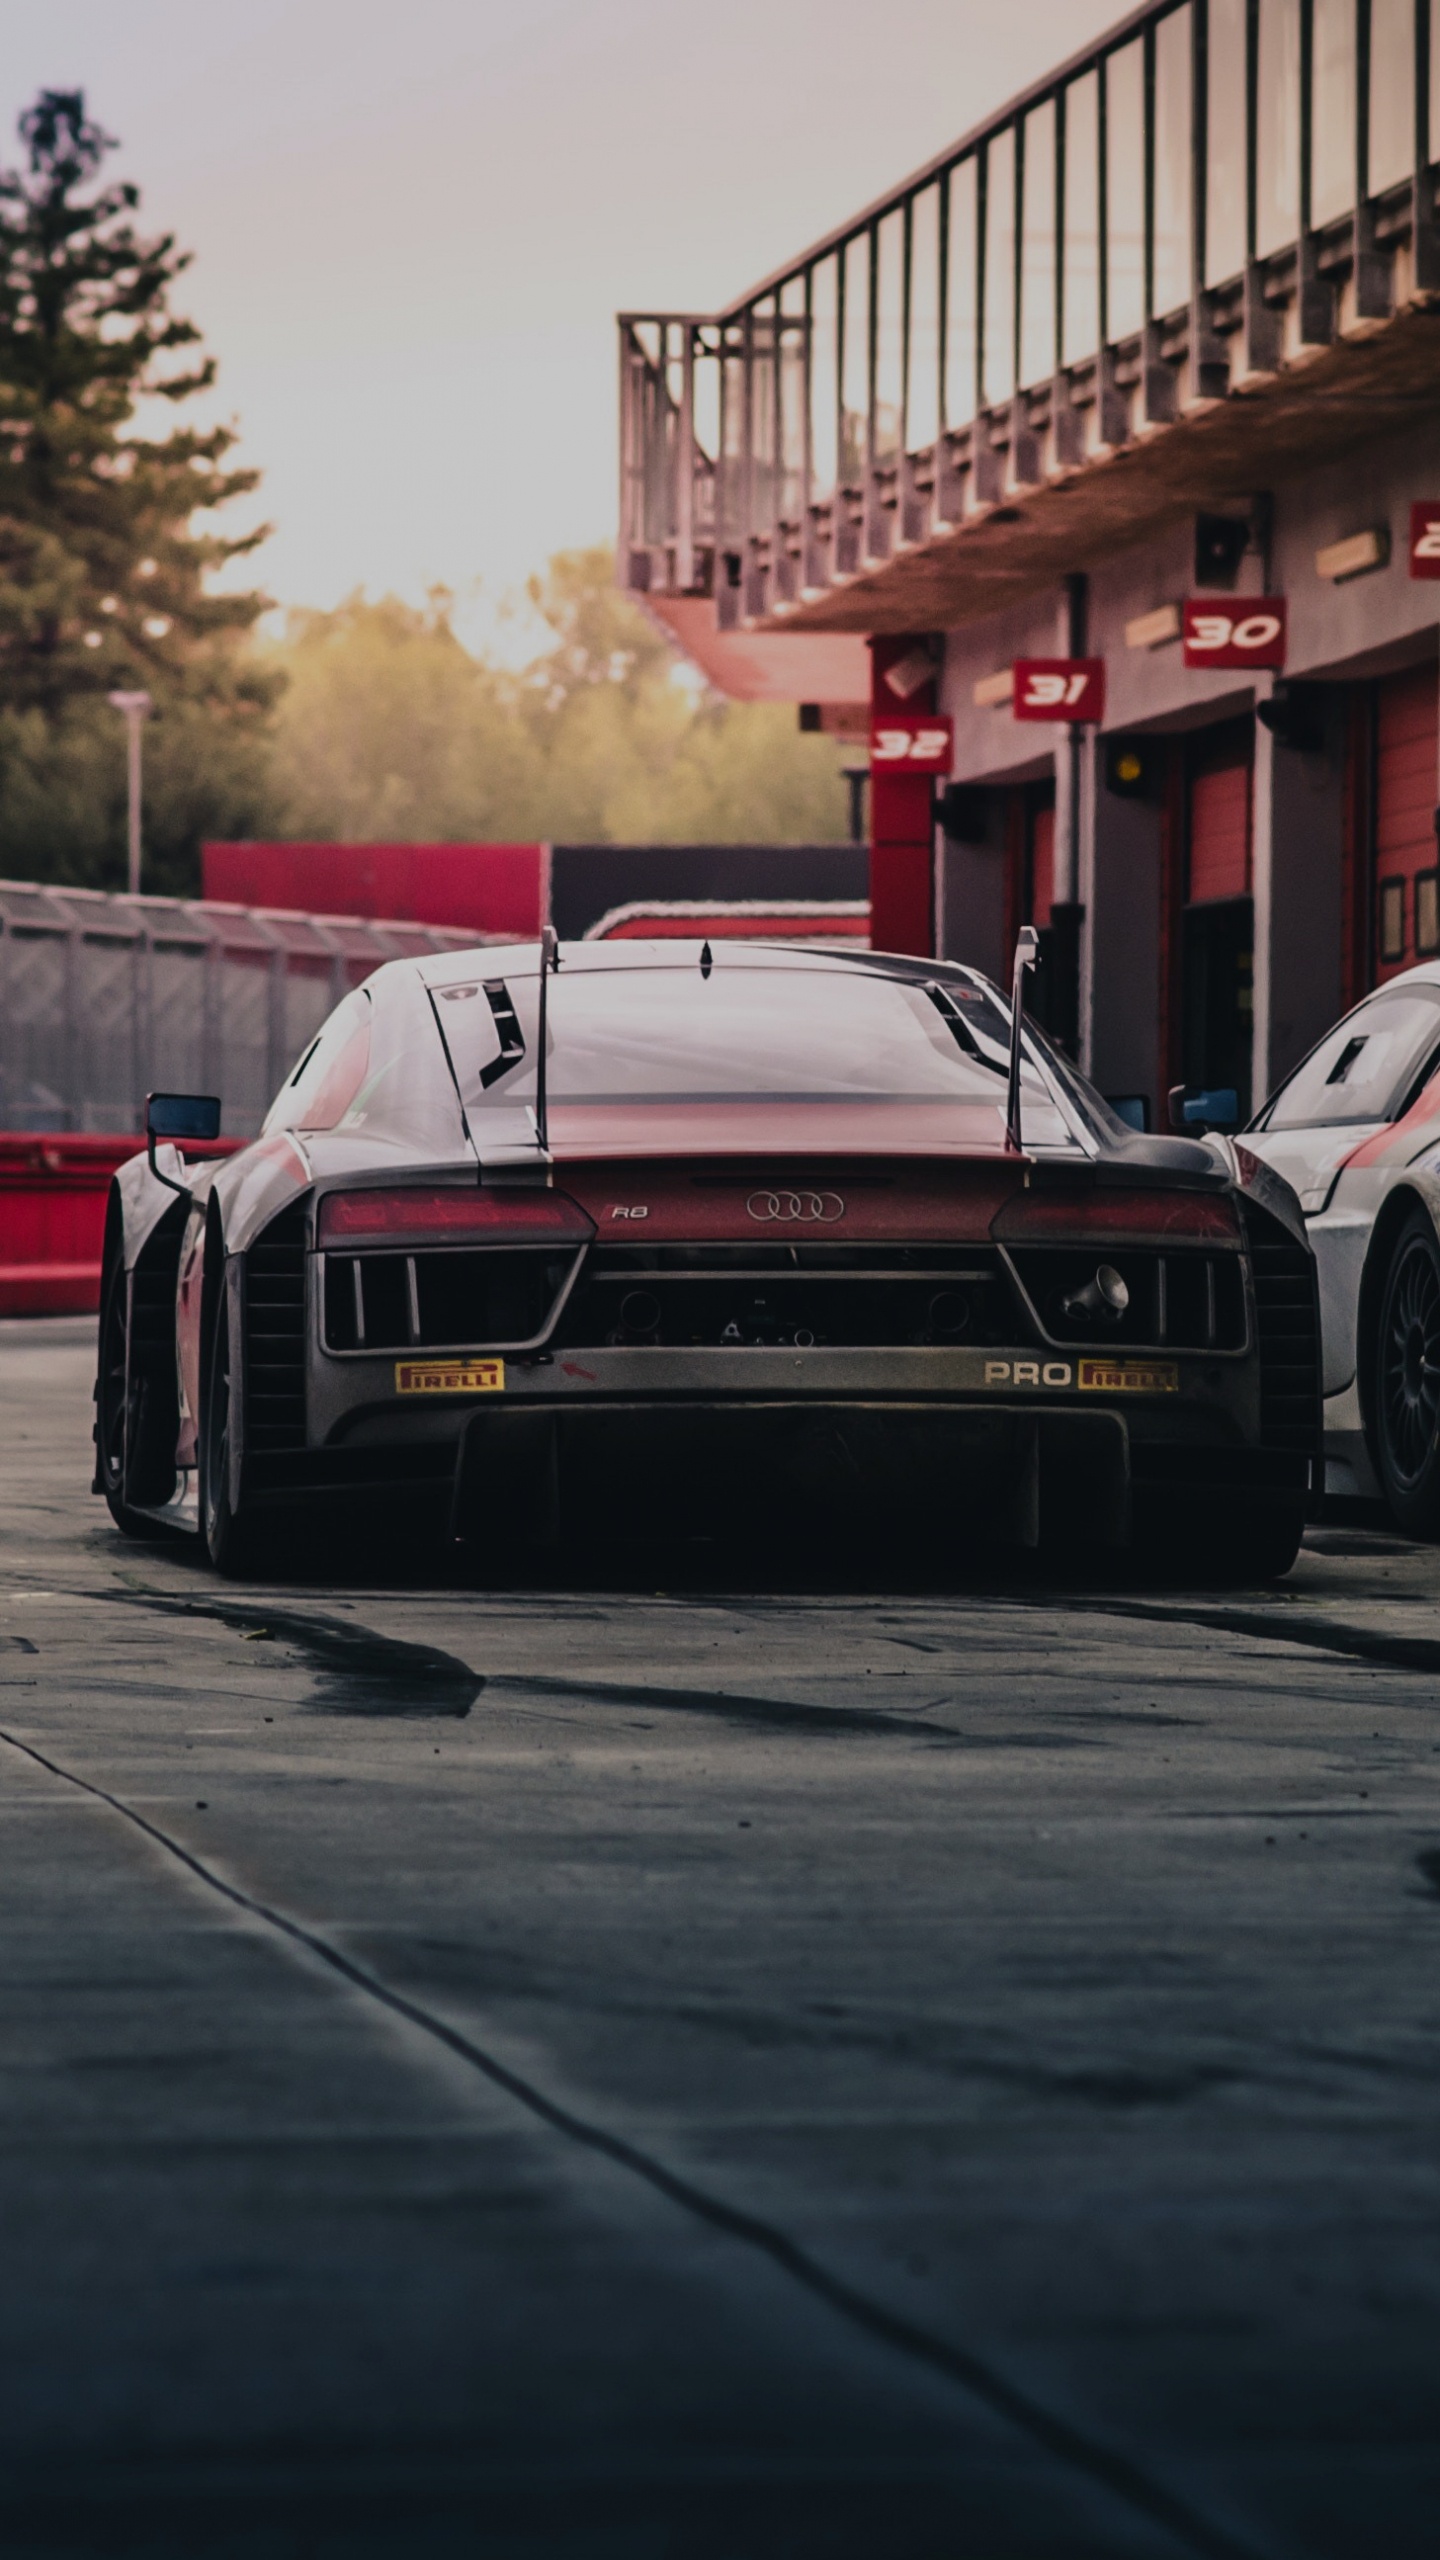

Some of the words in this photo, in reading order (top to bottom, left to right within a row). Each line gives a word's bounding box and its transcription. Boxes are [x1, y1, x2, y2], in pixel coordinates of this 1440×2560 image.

[1186, 615, 1281, 649] 30
[1024, 674, 1088, 706] 31
[873, 730, 948, 759] 32
[611, 1206, 648, 1219] R8
[400, 1364, 498, 1389] PIRELLI
[984, 1361, 1072, 1386] PRO
[1083, 1363, 1175, 1387] PIRELLI
